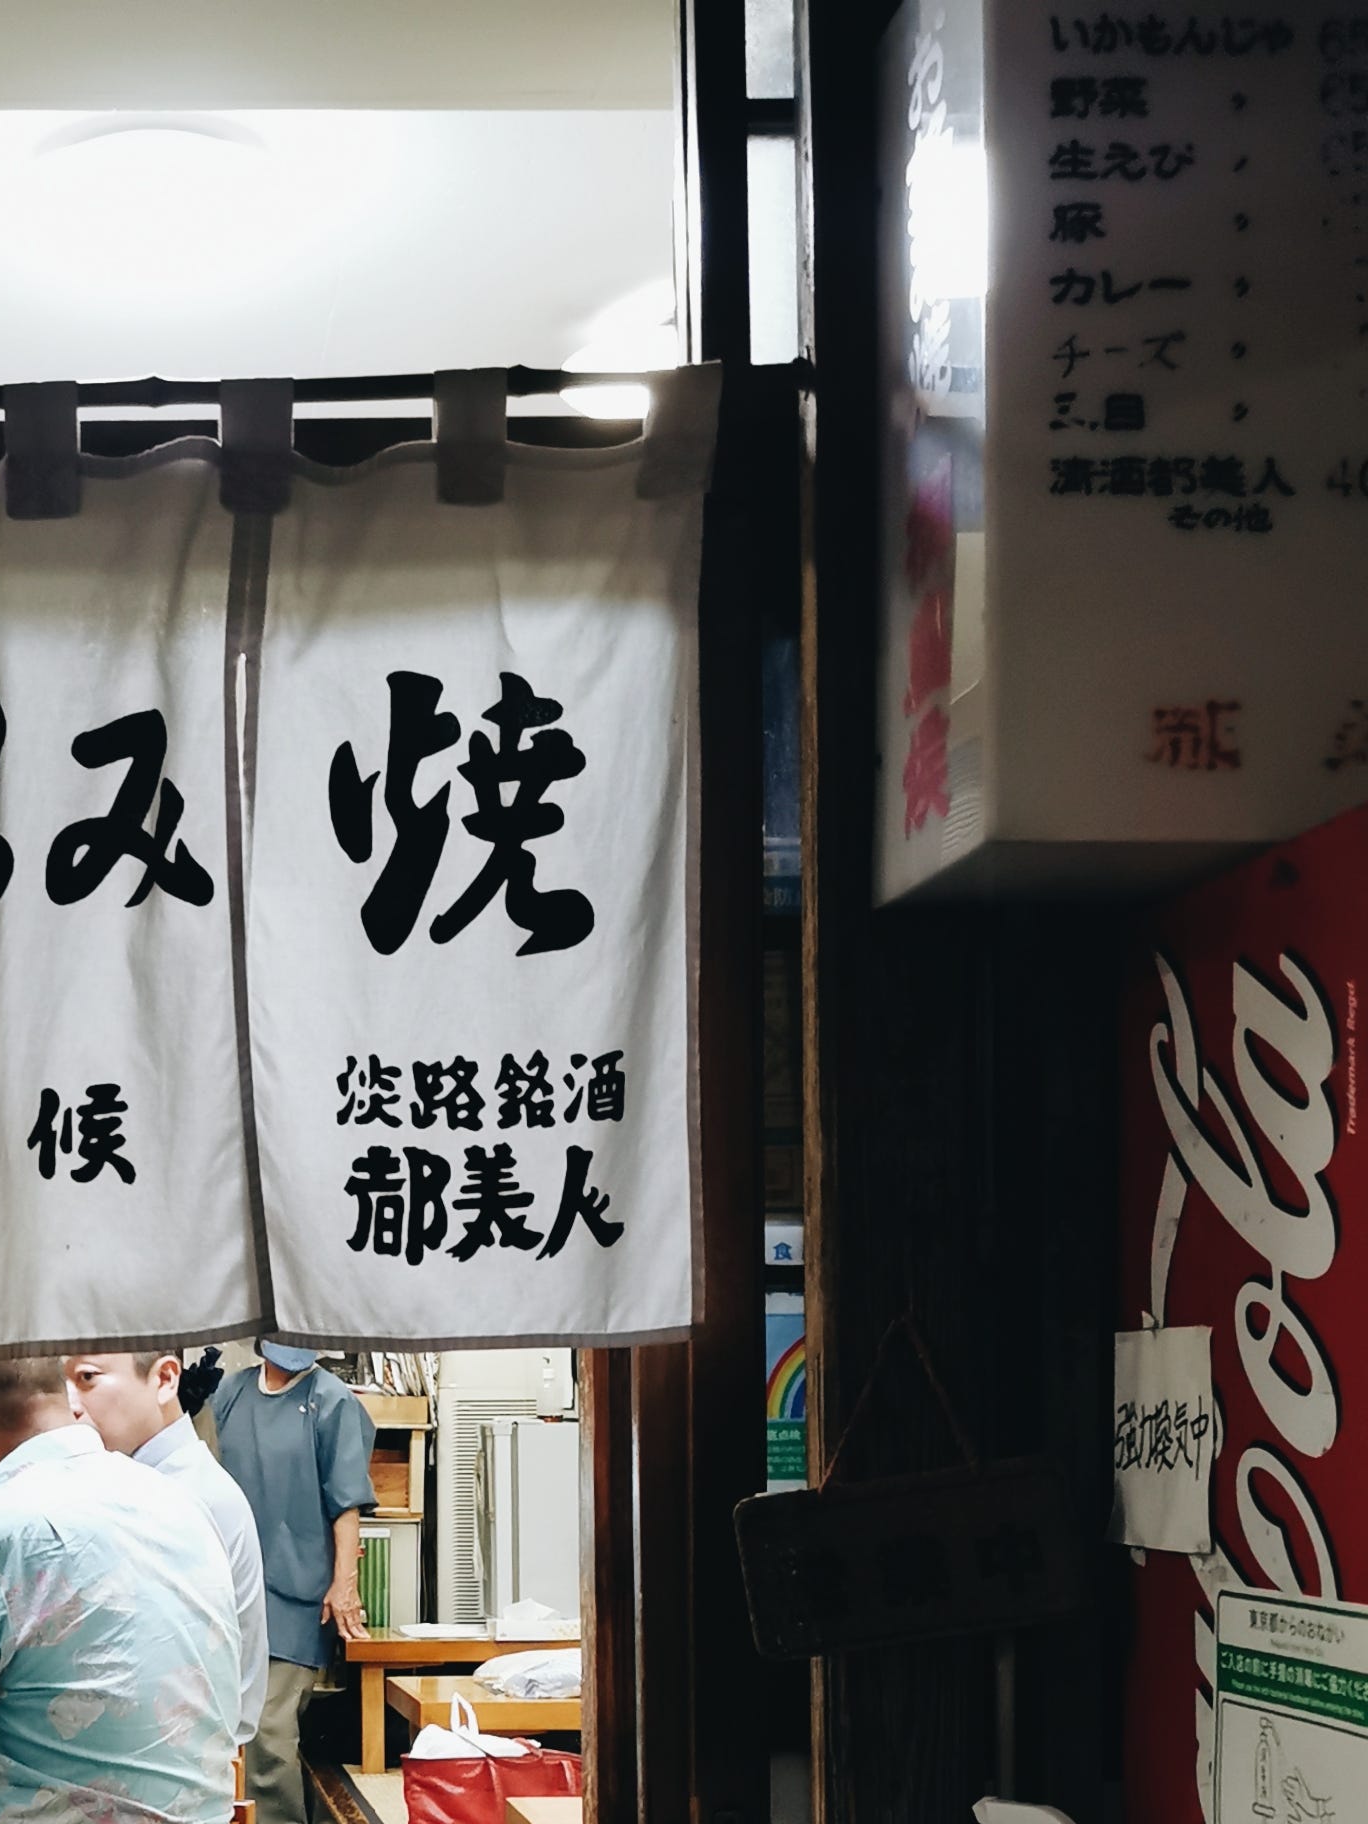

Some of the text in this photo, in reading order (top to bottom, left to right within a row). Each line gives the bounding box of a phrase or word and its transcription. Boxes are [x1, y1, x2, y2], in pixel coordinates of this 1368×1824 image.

[1049, 139, 1196, 180] 生えび
[1050, 267, 1192, 305] カレー
[336, 1049, 625, 1132] 淡路銘酒
[1346, 1036, 1358, 1136] Trademark
[344, 1142, 625, 1266] 都美人
